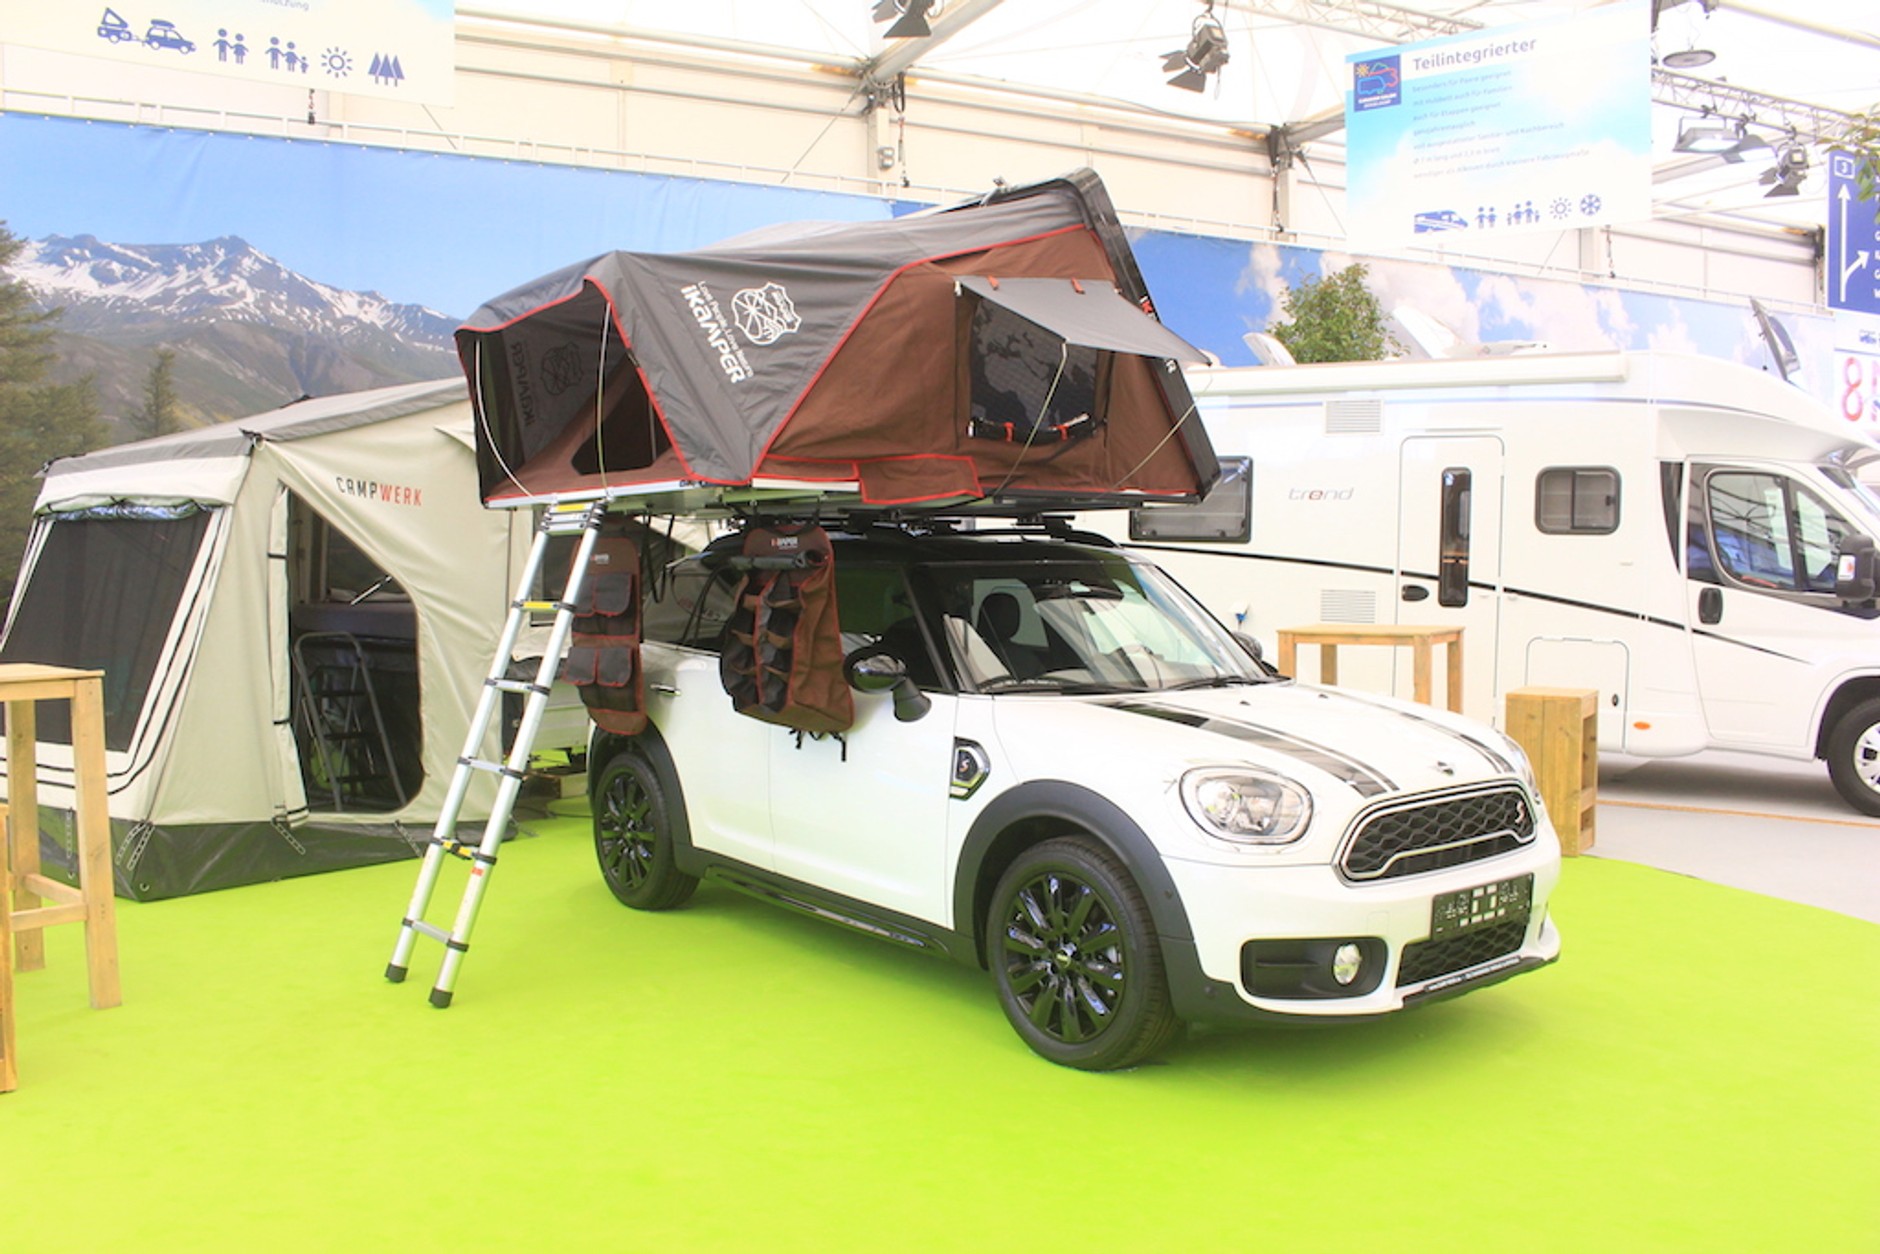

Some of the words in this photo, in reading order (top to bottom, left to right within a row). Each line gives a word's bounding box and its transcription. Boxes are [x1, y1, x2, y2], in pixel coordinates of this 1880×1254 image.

[1412, 38, 1537, 71] Teilintegrierter
[1841, 356, 1865, 423] 8
[335, 476, 422, 506] CAMPWERK
[1288, 487, 1355, 501] trend
